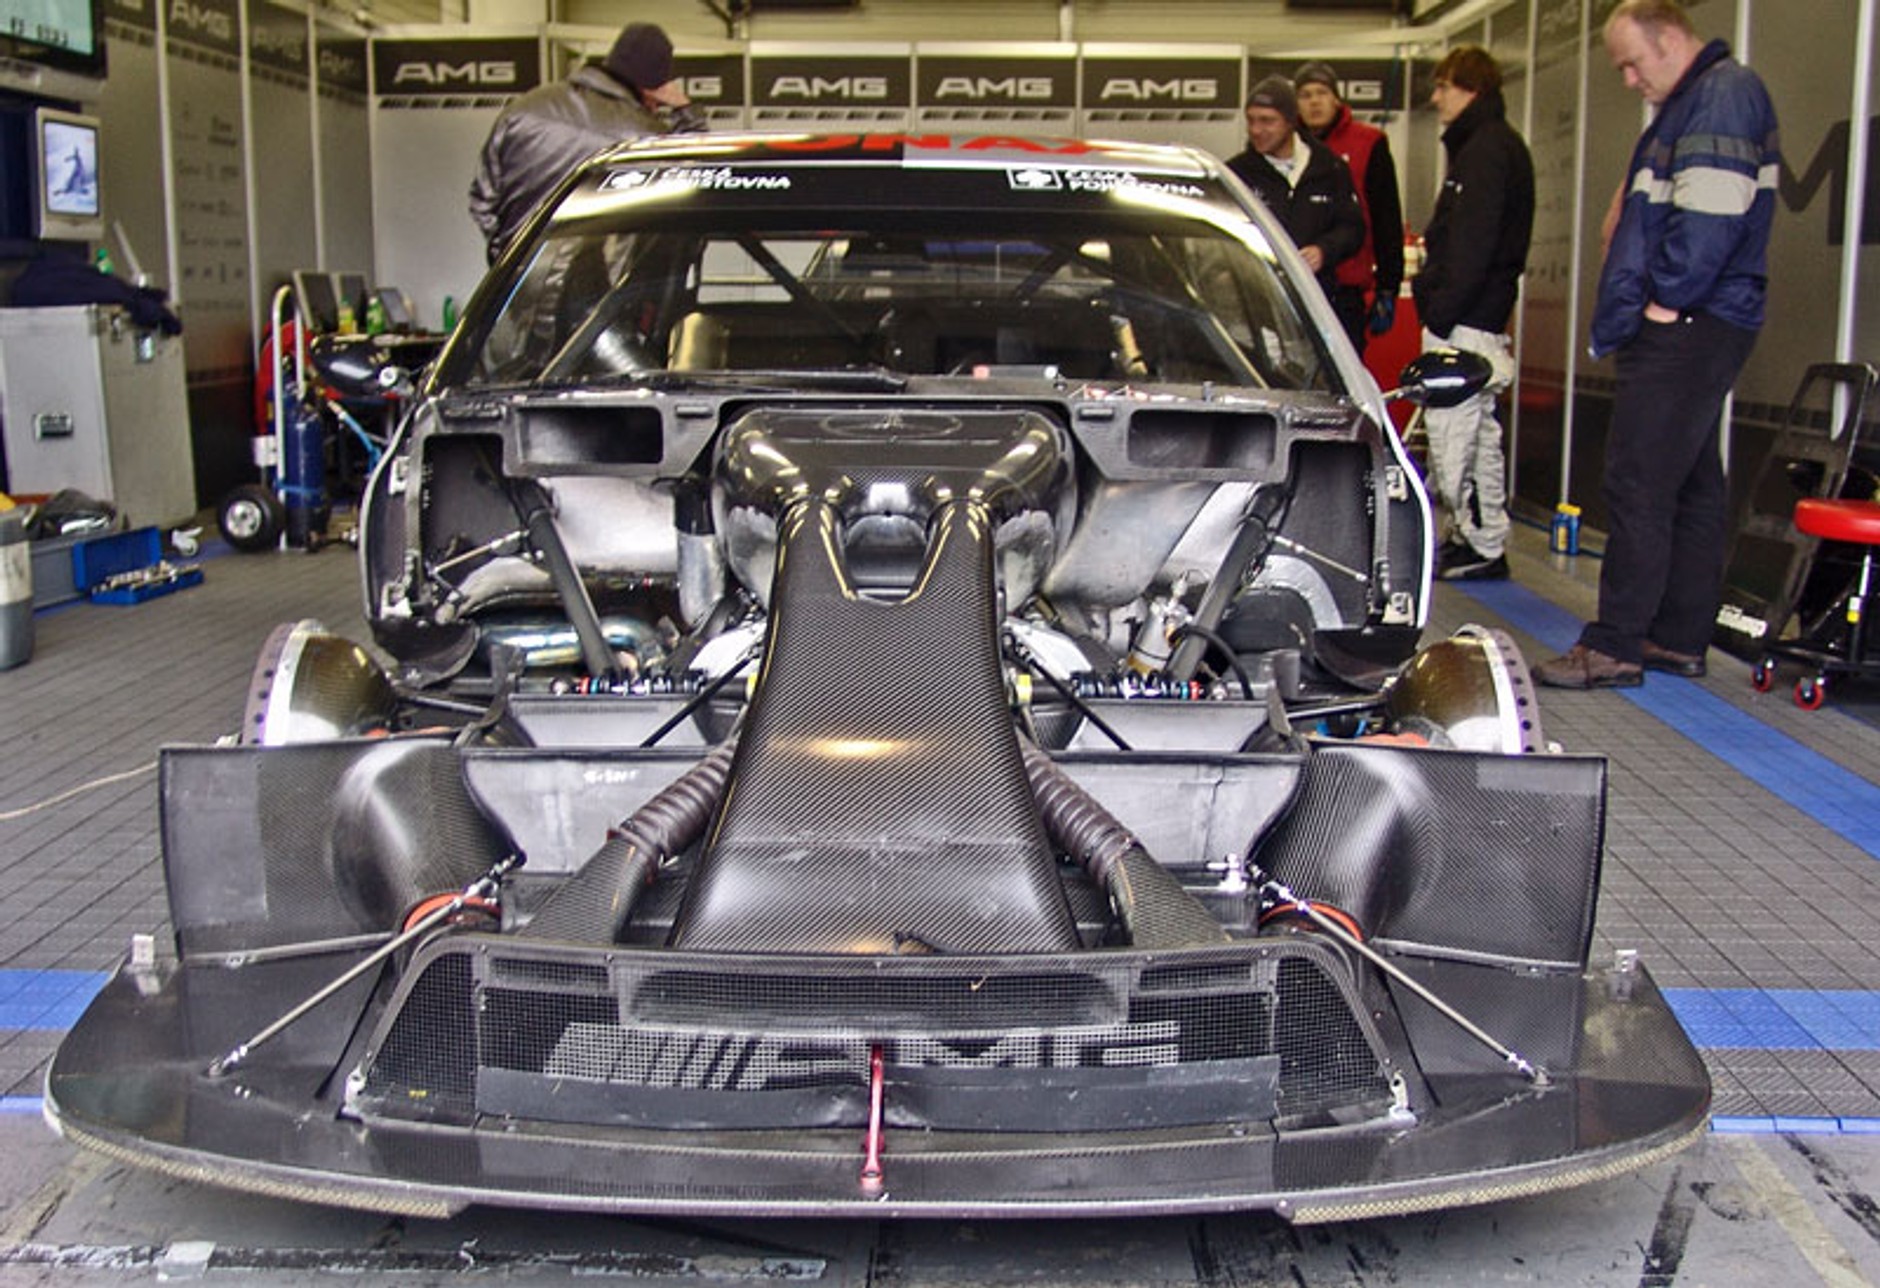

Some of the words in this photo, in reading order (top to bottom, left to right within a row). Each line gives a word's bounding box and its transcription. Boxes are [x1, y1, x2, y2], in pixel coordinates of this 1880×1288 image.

[394, 61, 516, 84] AMG
[770, 77, 888, 98] AMG
[935, 77, 1054, 98] AMG
[1101, 78, 1219, 100] AMG
[755, 1020, 1181, 1092] AMG
